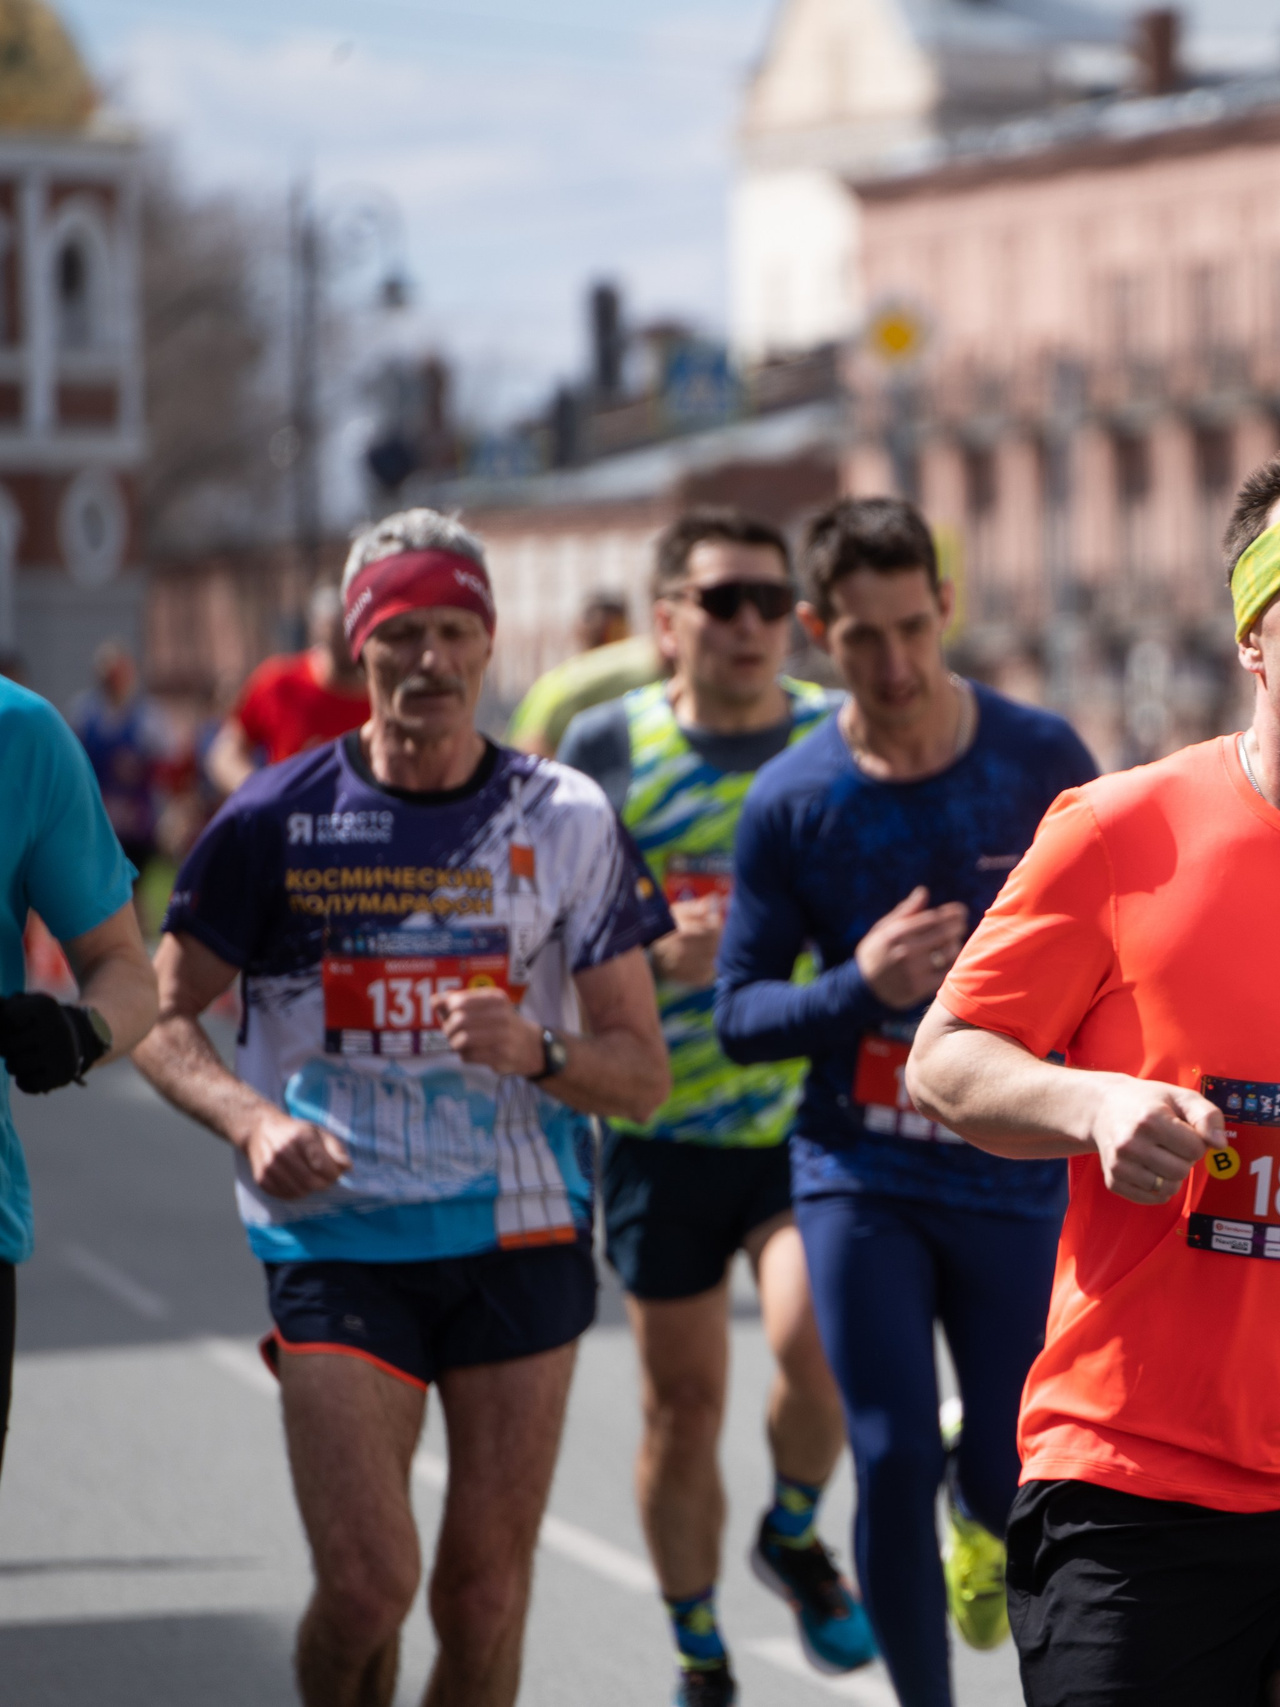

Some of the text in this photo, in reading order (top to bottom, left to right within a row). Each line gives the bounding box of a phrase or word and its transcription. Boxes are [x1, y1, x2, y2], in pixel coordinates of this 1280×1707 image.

[286, 811, 393, 845] Я ПРОСТО
[316, 826, 393, 844] КОСМОС
[285, 867, 493, 890] КОСМИЧЕСКИЙ
[289, 892, 495, 916] ПОЛУМАРАФОН
[1213, 1152, 1233, 1172] B
